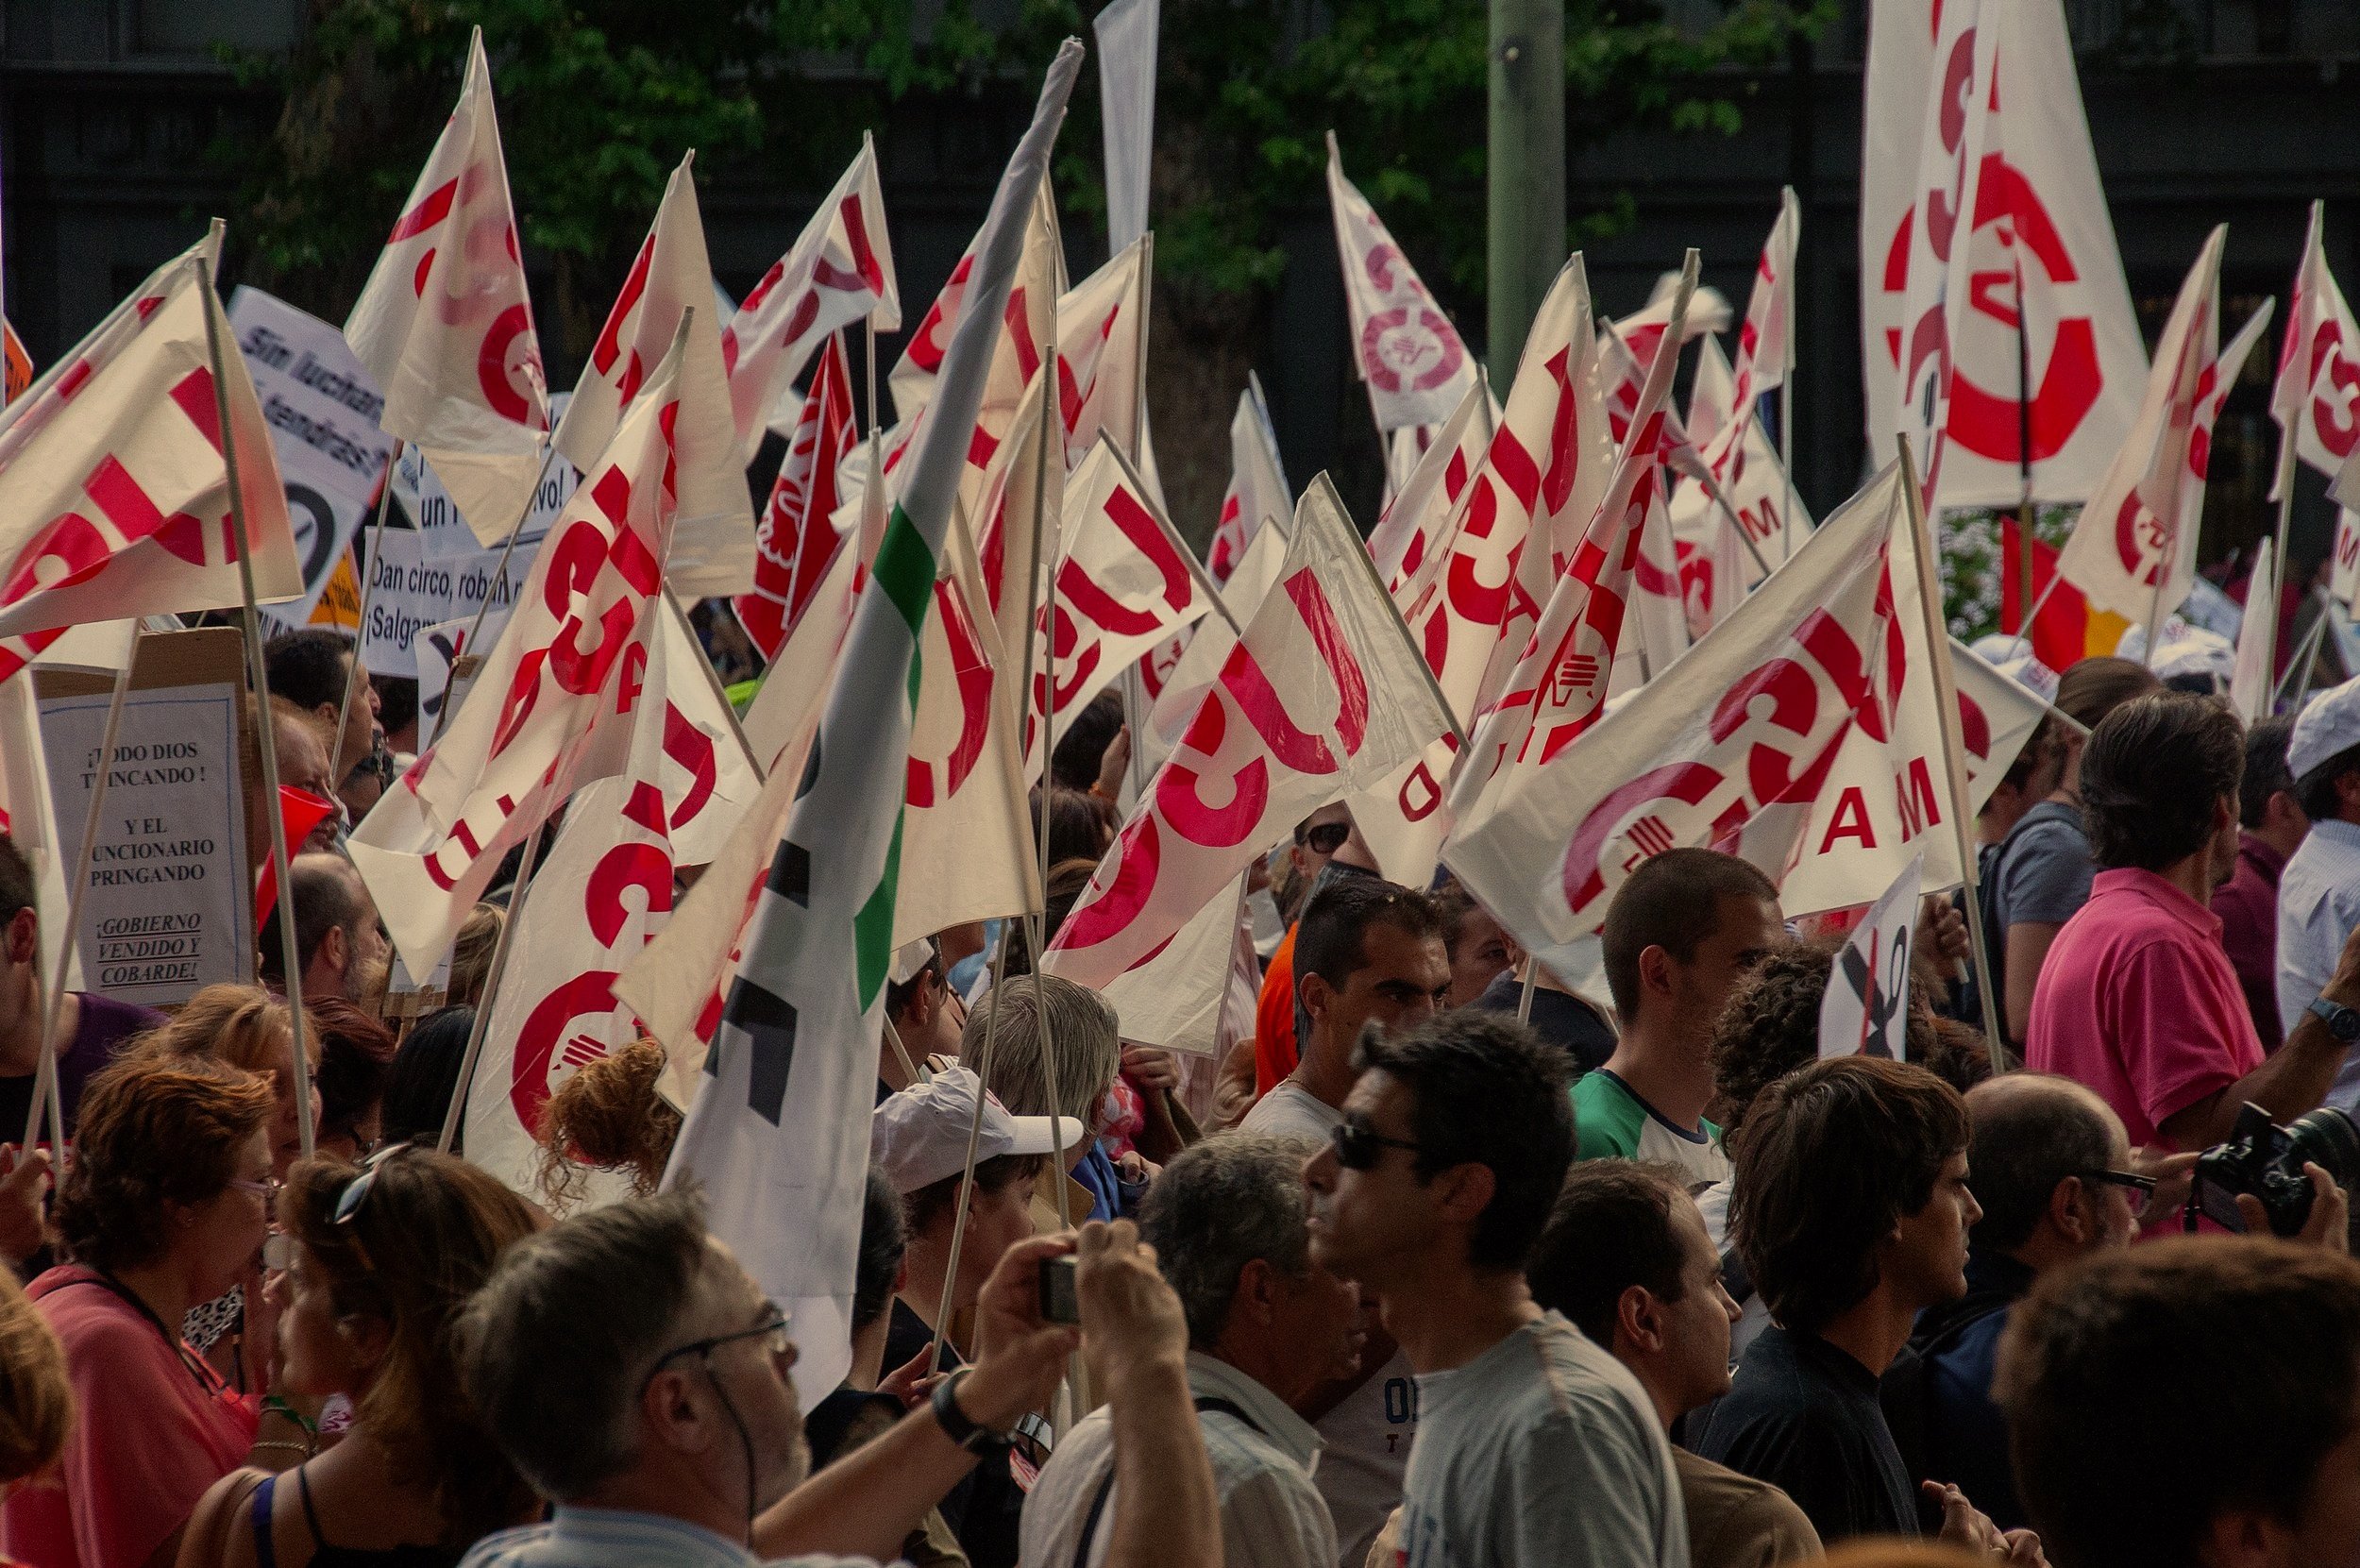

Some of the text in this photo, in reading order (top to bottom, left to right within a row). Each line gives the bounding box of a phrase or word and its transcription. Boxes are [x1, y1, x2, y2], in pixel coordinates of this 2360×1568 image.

[241, 327, 293, 371] Sin
[421, 496, 445, 528] un
[373, 556, 403, 590] Dan
[409, 560, 453, 604] circo,
[152, 741, 198, 761] DIOS
[81, 767, 195, 790] TINCANDO
[124, 818, 168, 835] Y EL
[92, 838, 214, 863] UNCIONARIO
[91, 863, 205, 887] PRINGANDO
[96, 913, 201, 939] ¡GOBIERNO
[98, 936, 201, 960] VENDIDO Y
[101, 962, 196, 985] COBARDE!
